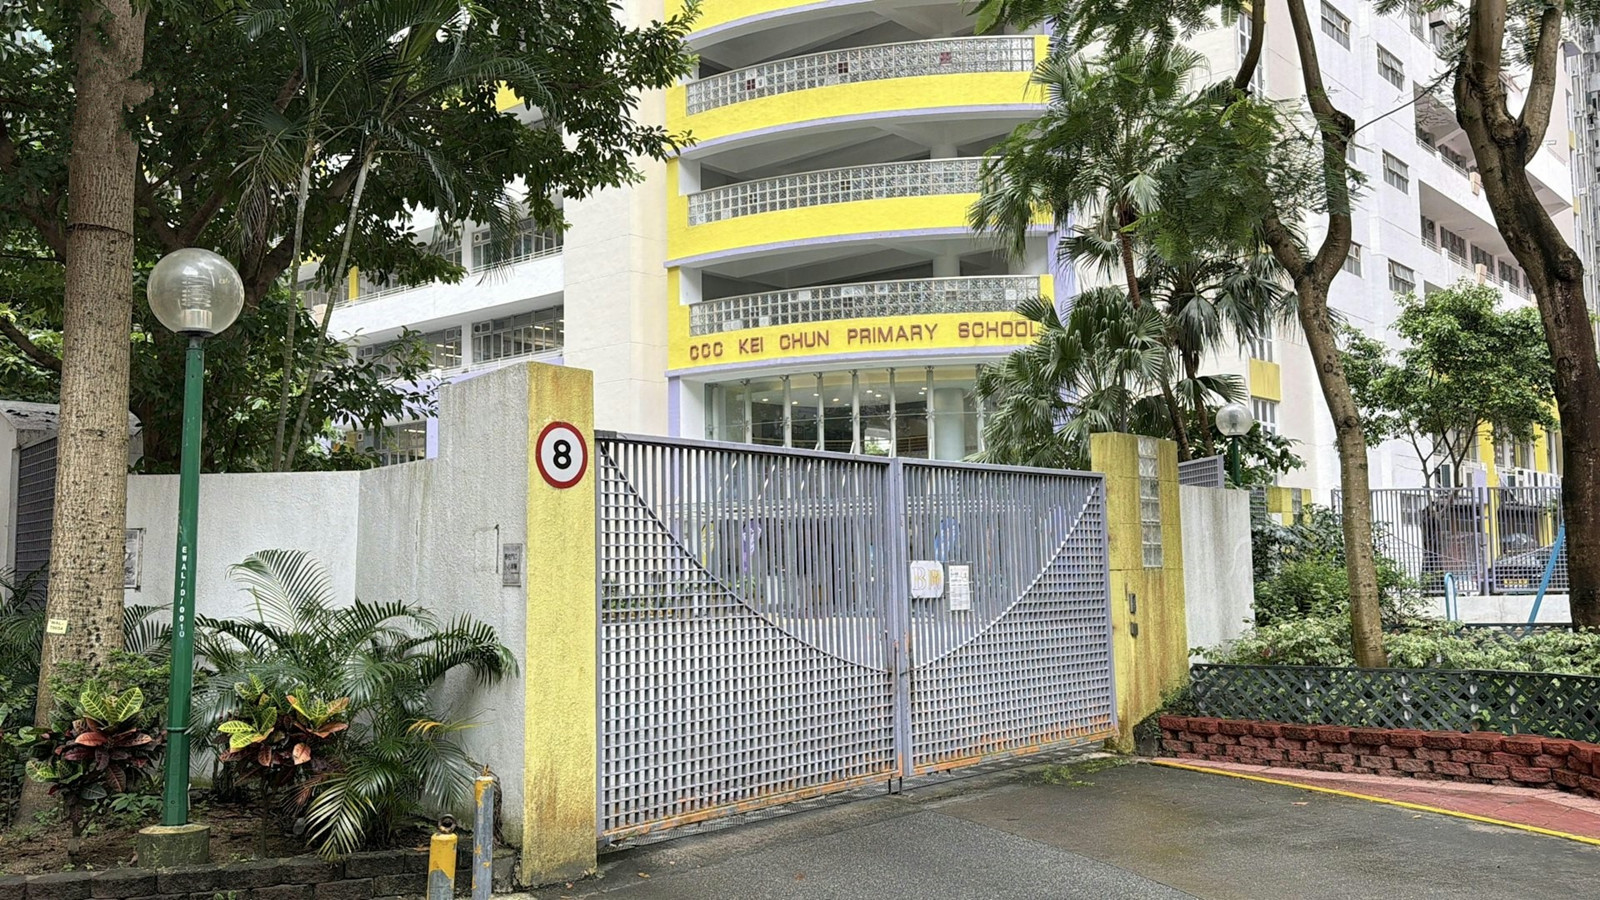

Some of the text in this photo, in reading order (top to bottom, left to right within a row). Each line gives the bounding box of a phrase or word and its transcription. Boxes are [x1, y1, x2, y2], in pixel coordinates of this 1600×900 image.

[690, 320, 1037, 361] CCC KEI CHUN PRIMARY SCHOOL
[552, 439, 572, 470] 8
